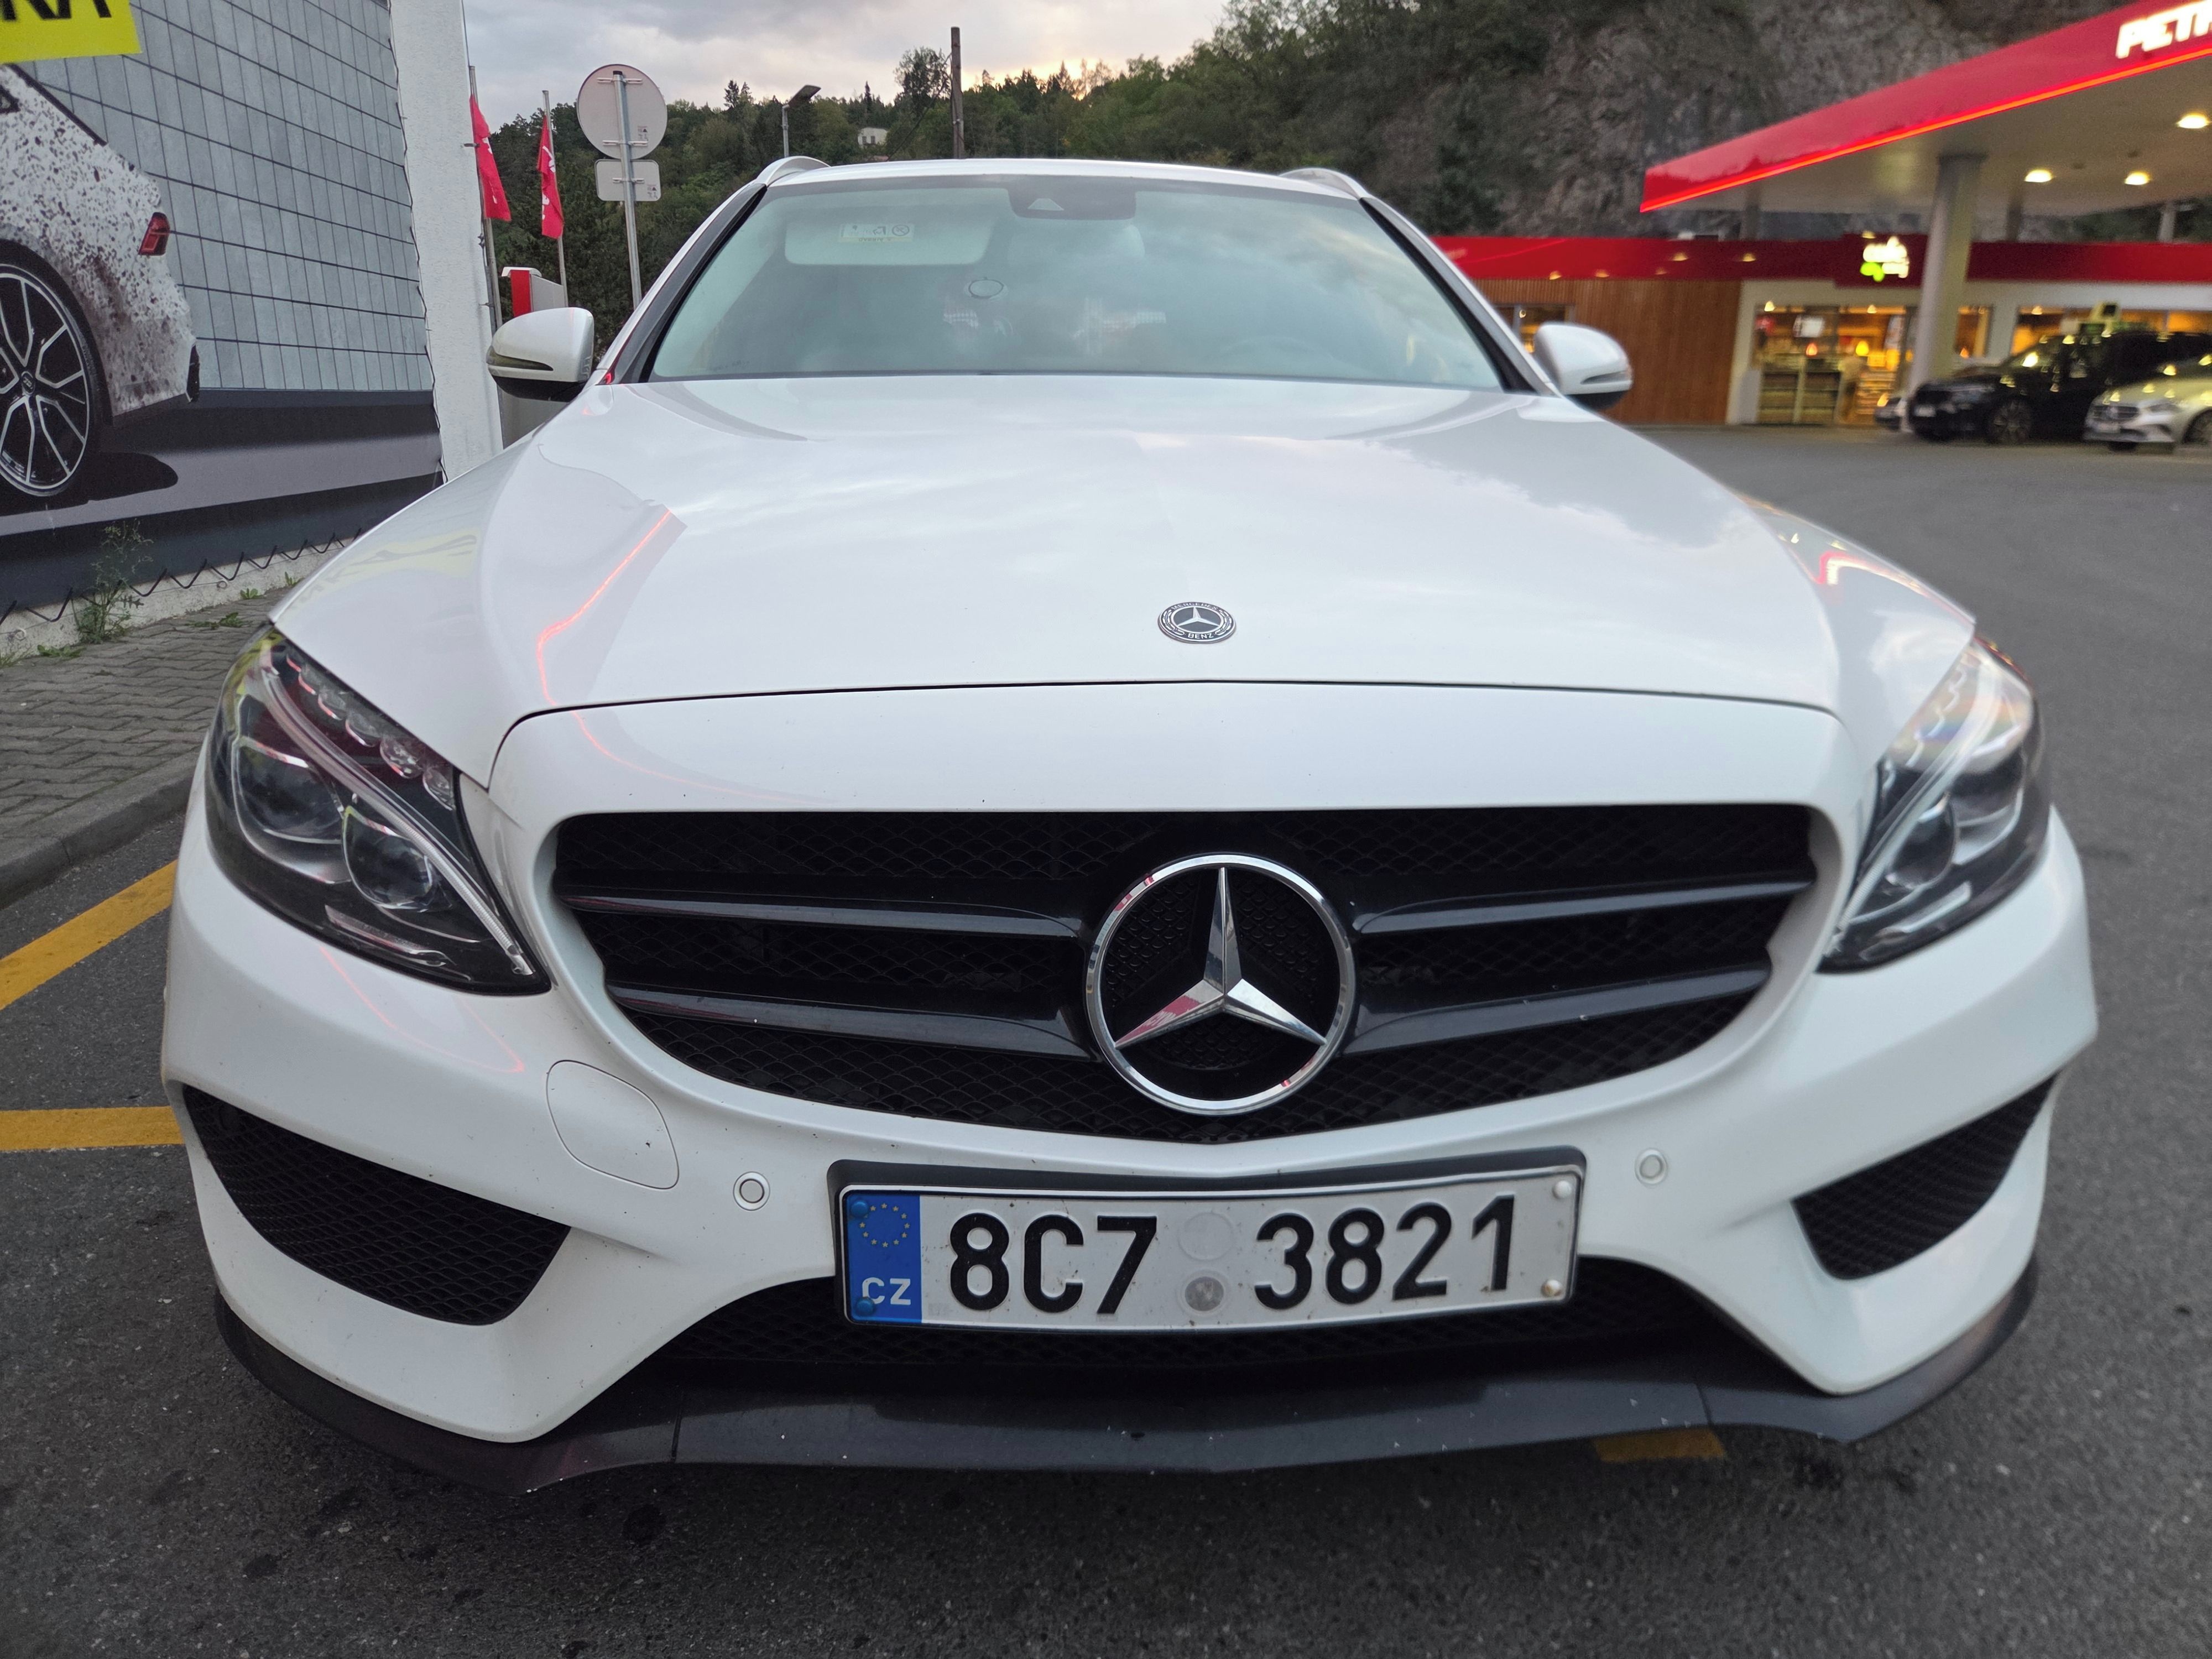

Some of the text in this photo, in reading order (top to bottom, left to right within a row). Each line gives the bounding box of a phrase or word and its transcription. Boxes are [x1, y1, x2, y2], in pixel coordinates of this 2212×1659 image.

[862, 1276, 911, 1306] CZ
[949, 1195, 1515, 1315] 8C7 3821
